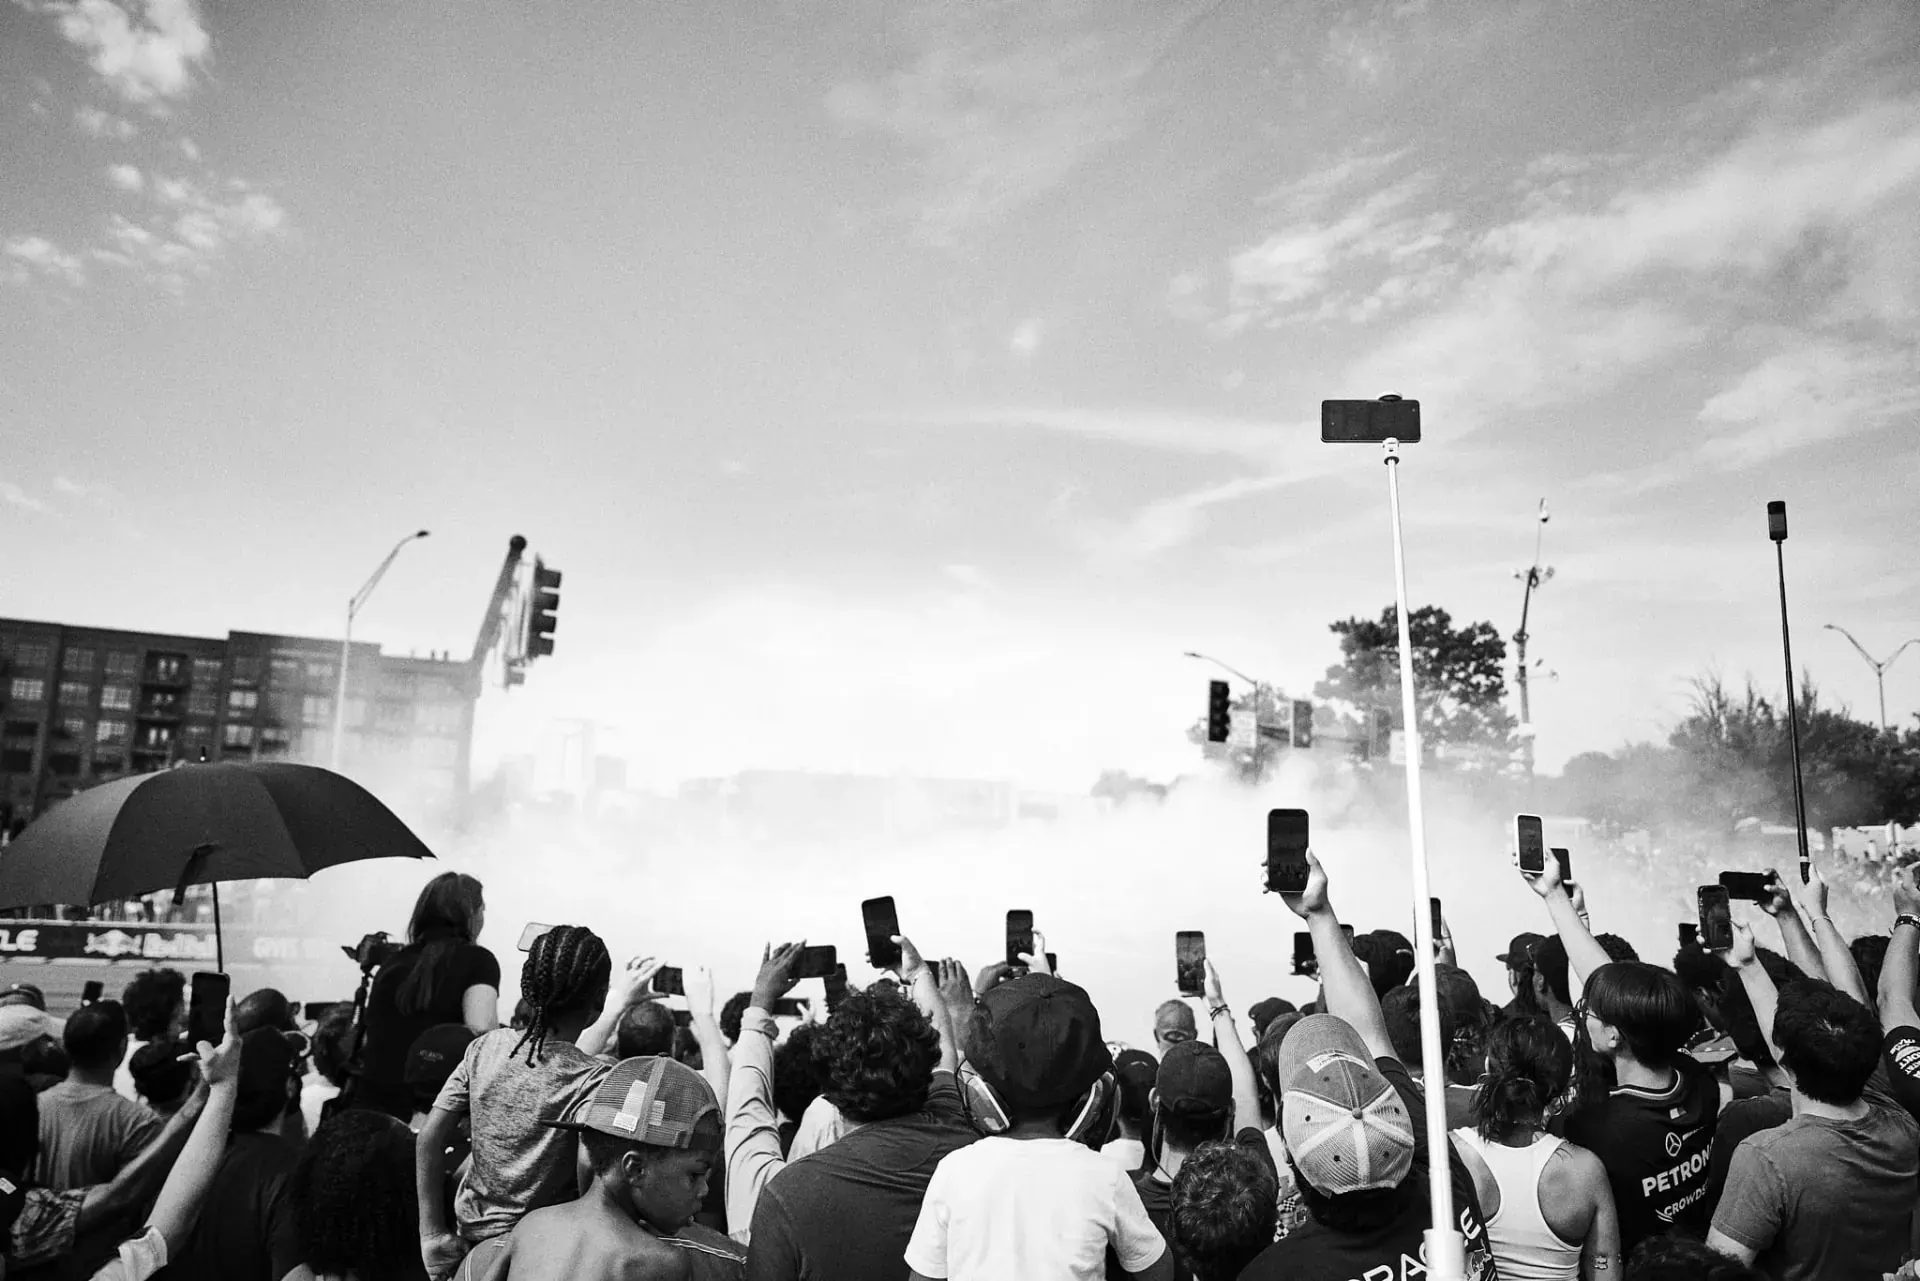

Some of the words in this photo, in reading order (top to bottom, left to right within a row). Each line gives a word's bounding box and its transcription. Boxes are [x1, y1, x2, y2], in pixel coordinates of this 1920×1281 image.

[0, 929, 39, 951] LE
[1642, 1136, 1714, 1197] PETRON
[1663, 1177, 1709, 1216] CROWDS
